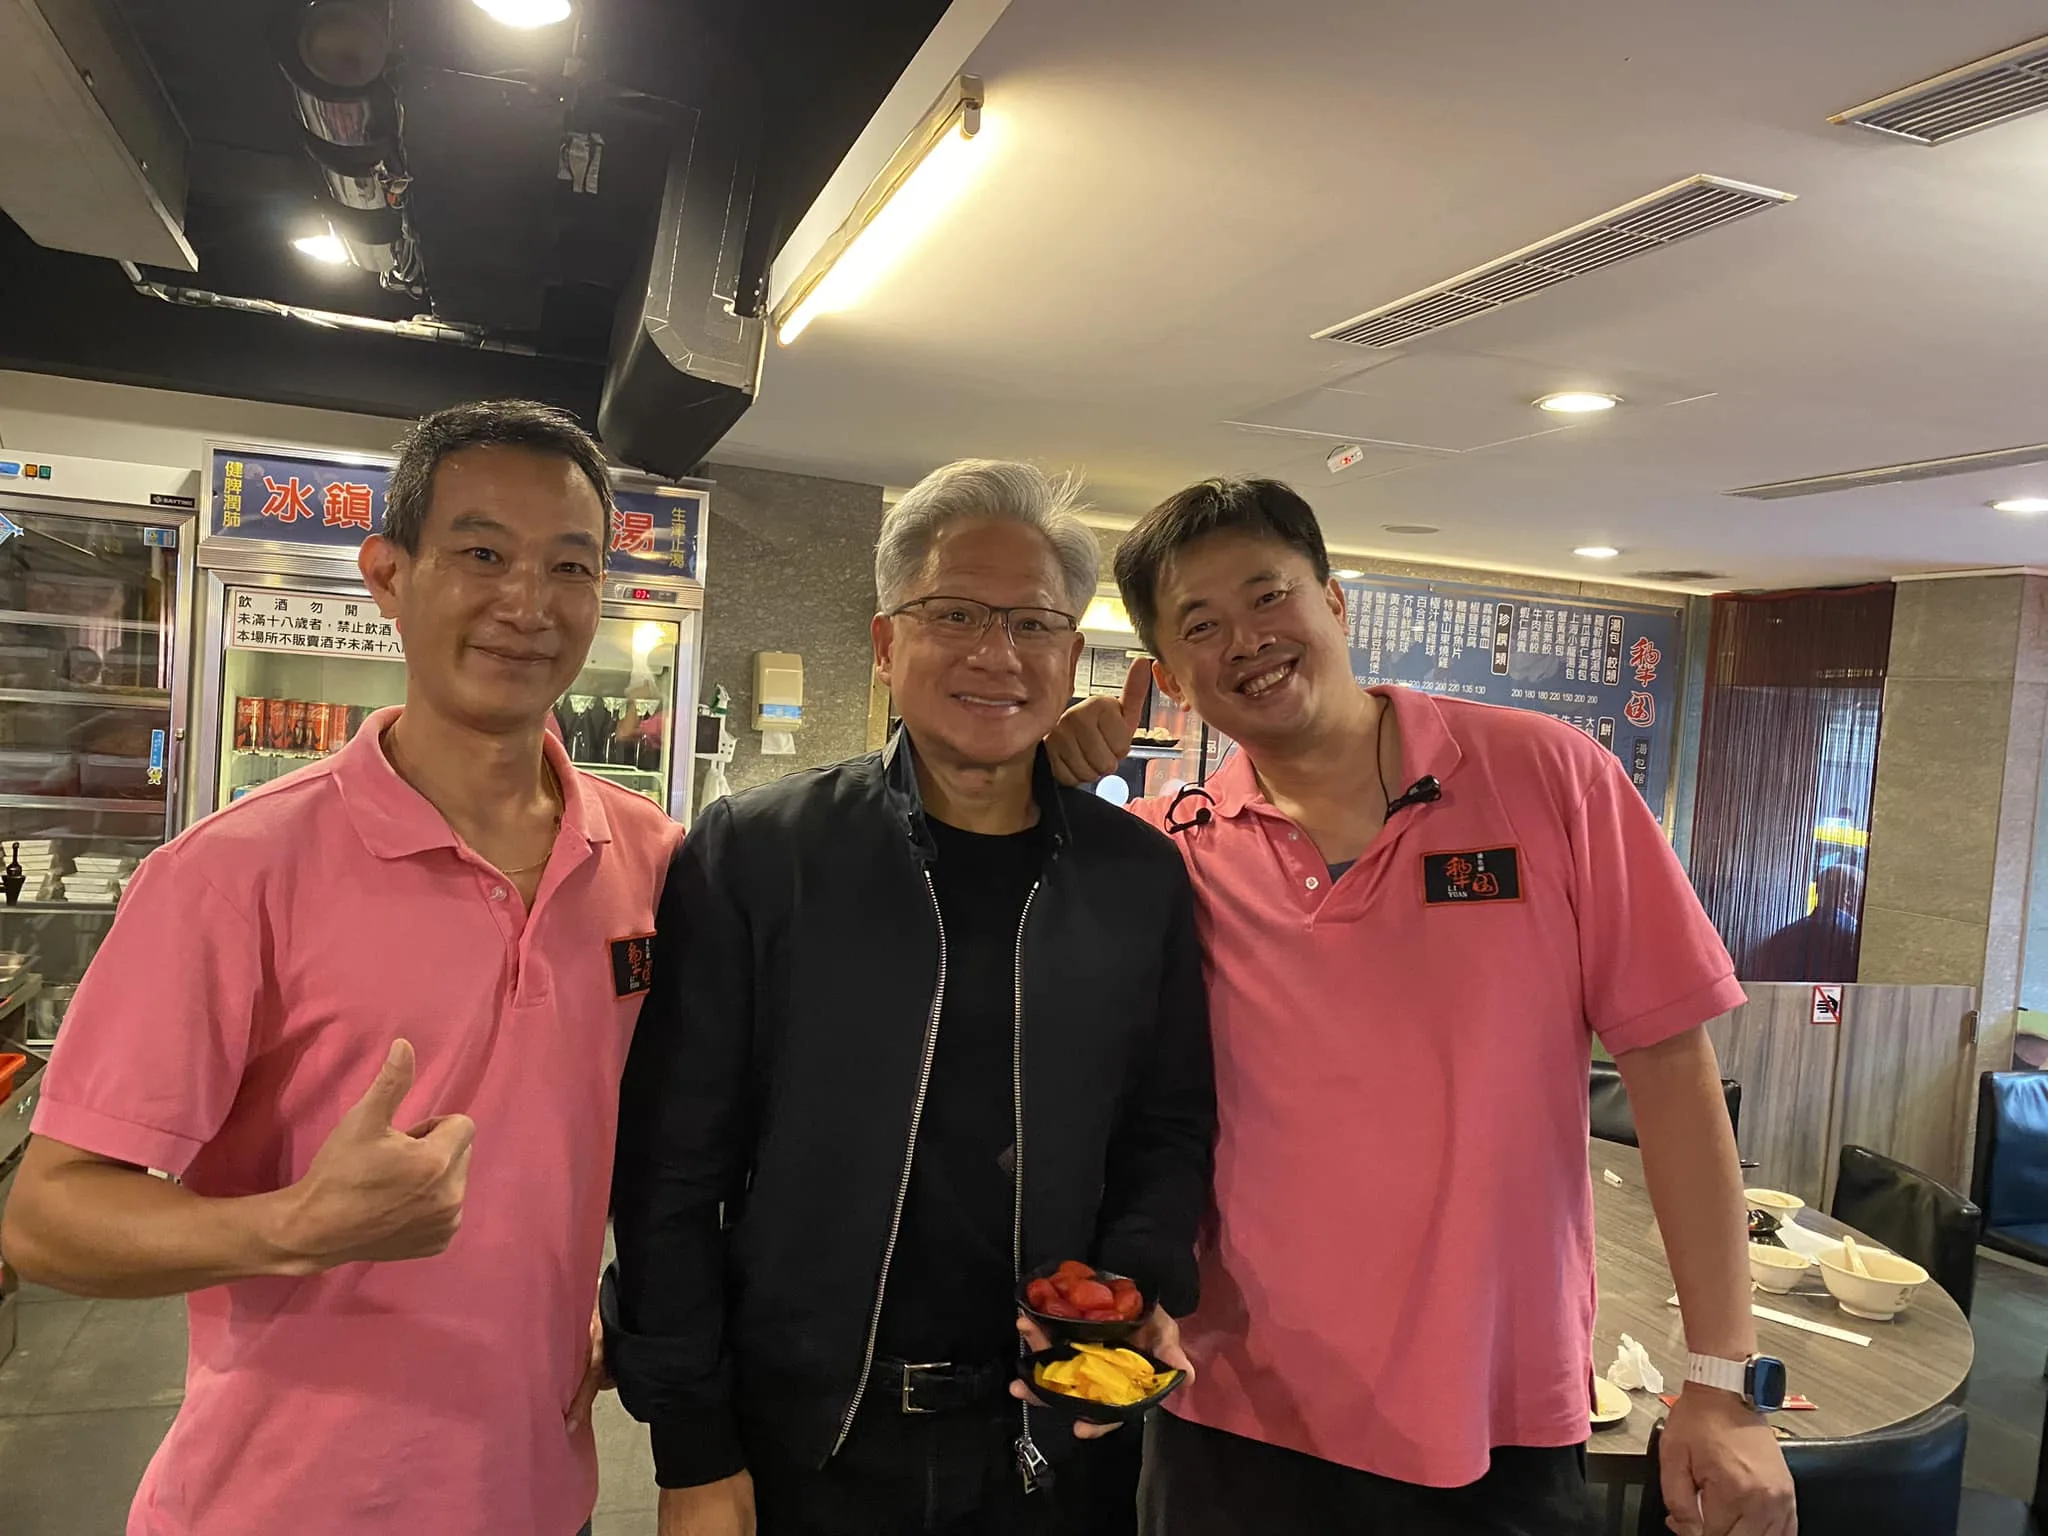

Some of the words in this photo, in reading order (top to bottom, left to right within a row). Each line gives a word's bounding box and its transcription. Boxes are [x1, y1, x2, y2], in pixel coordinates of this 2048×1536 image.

[223, 461, 243, 527] 健脾潤肺
[261, 475, 388, 531] 冰鎮
[610, 510, 655, 553] 湯
[237, 630, 404, 653] 本場所不販賣酒予未滿十八
[1448, 683, 1459, 692] 220
[1511, 688, 1523, 698] 200
[1524, 689, 1536, 698] 180
[1549, 691, 1560, 701] 220
[1562, 693, 1573, 702] 150
[1574, 694, 1585, 703] 200
[1587, 695, 1598, 704] 200
